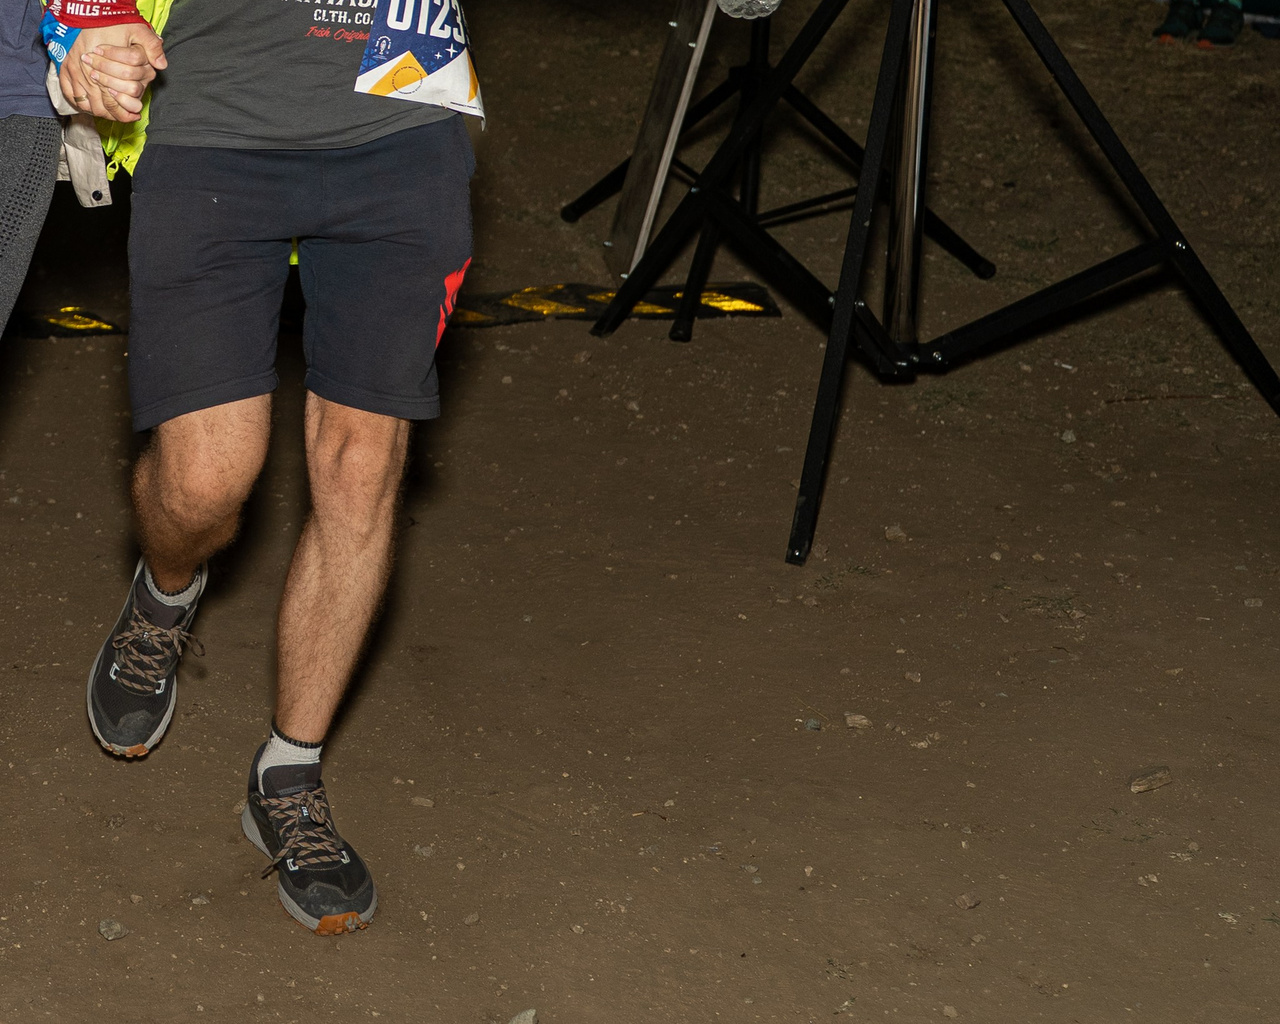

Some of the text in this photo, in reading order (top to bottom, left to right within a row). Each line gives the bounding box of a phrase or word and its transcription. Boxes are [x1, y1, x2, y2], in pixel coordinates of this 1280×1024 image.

[66, 2, 101, 16] HILLS
[313, 9, 351, 23] CLTH.
[305, 26, 371, 43] Irish Origina
